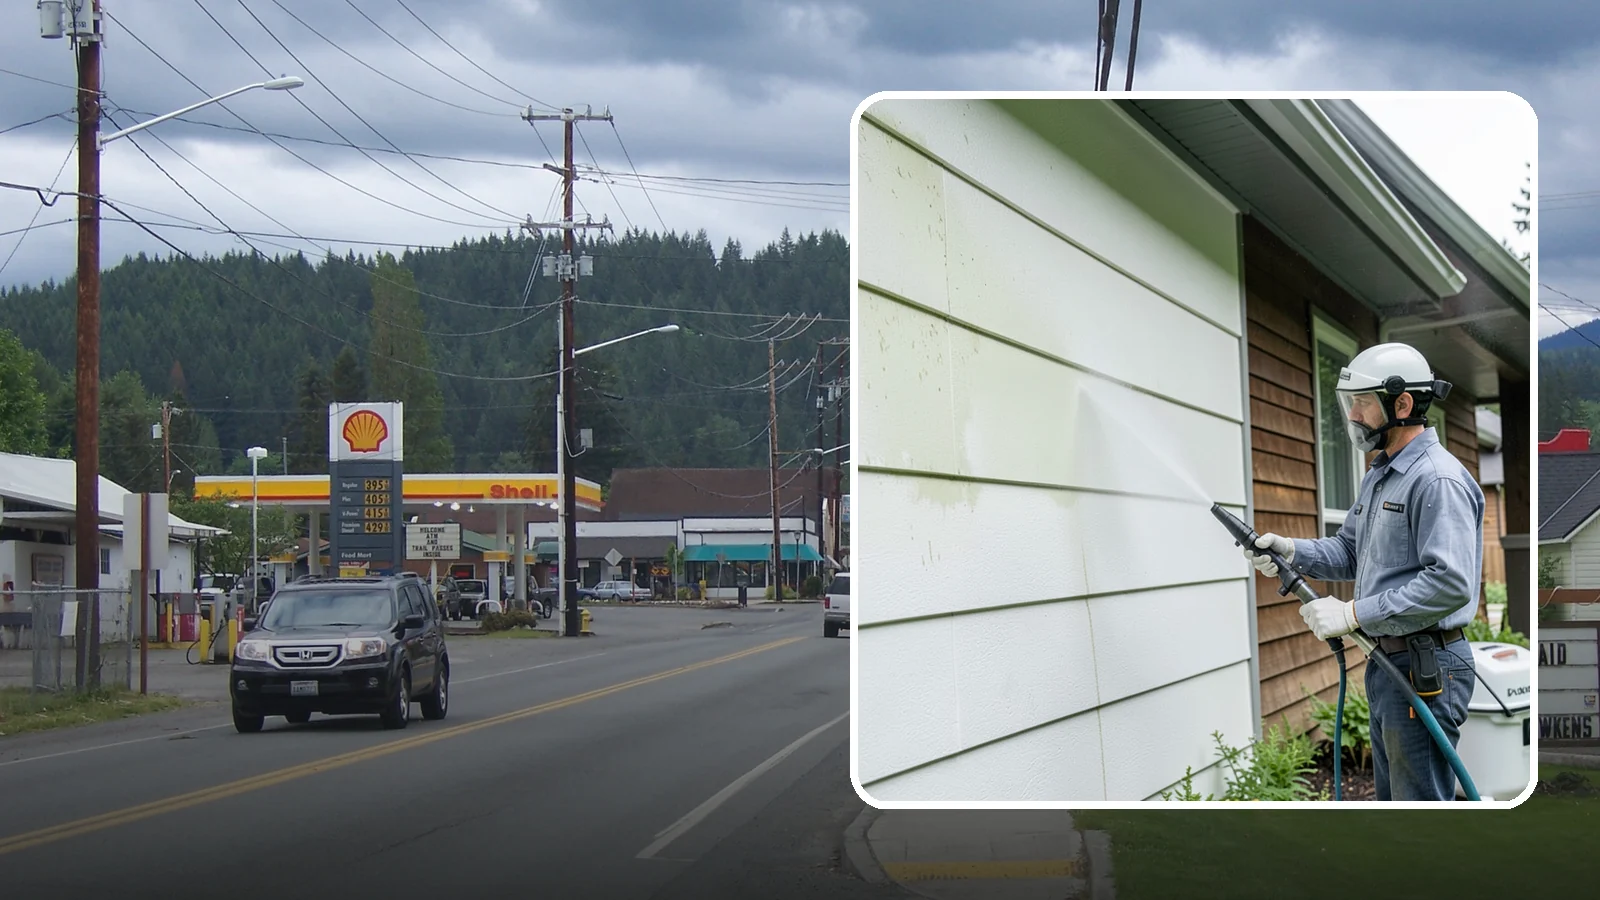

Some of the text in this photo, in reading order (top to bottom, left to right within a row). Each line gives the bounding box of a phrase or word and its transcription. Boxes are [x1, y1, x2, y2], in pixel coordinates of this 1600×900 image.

[366, 480, 384, 490] 395
[490, 484, 547, 499] Shell
[366, 494, 384, 504] 405
[366, 508, 383, 518] 415
[366, 522, 383, 532] 429
[1538, 642, 1566, 665] AID
